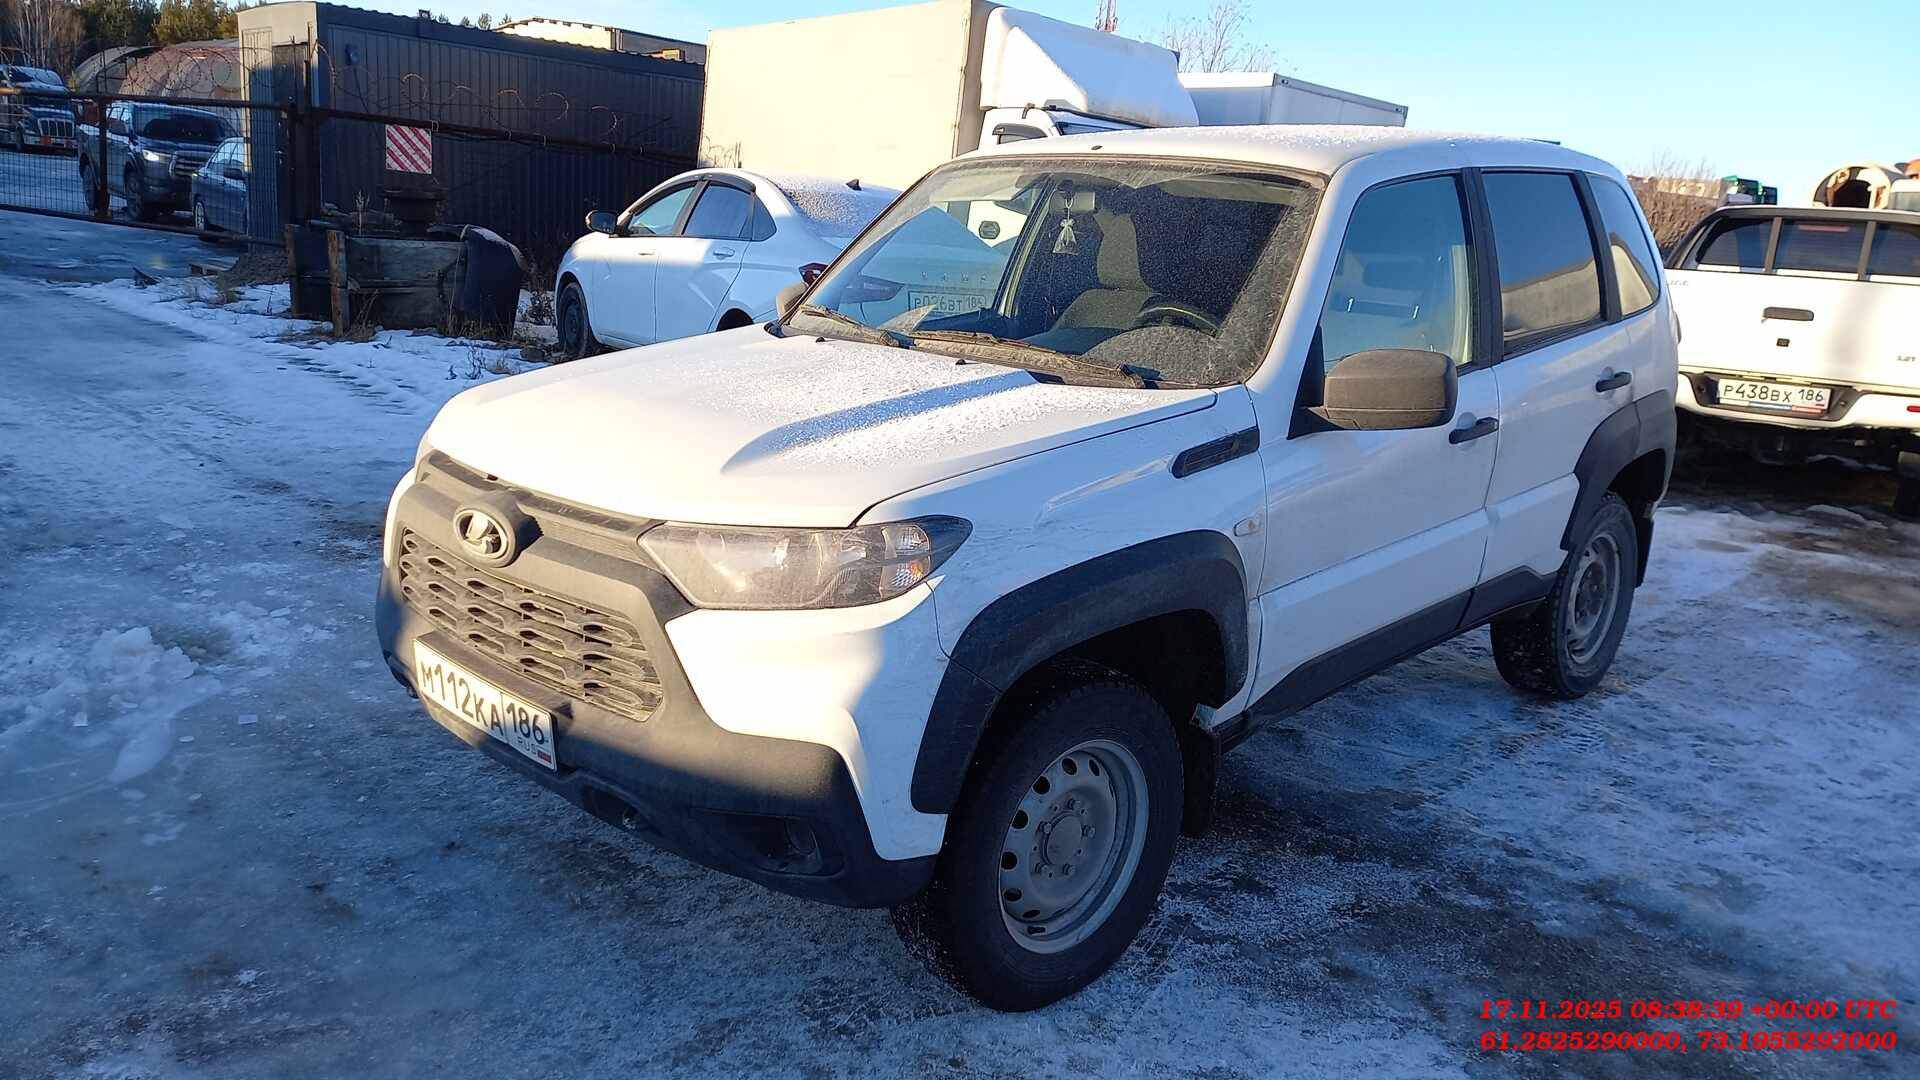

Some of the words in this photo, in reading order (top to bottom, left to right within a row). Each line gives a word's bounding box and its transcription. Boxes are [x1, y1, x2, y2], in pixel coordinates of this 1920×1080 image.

[1723, 383, 1792, 402] Р438ВХ
[1797, 389, 1825, 402] 186
[420, 661, 504, 737] М112КА
[506, 702, 546, 745] 186
